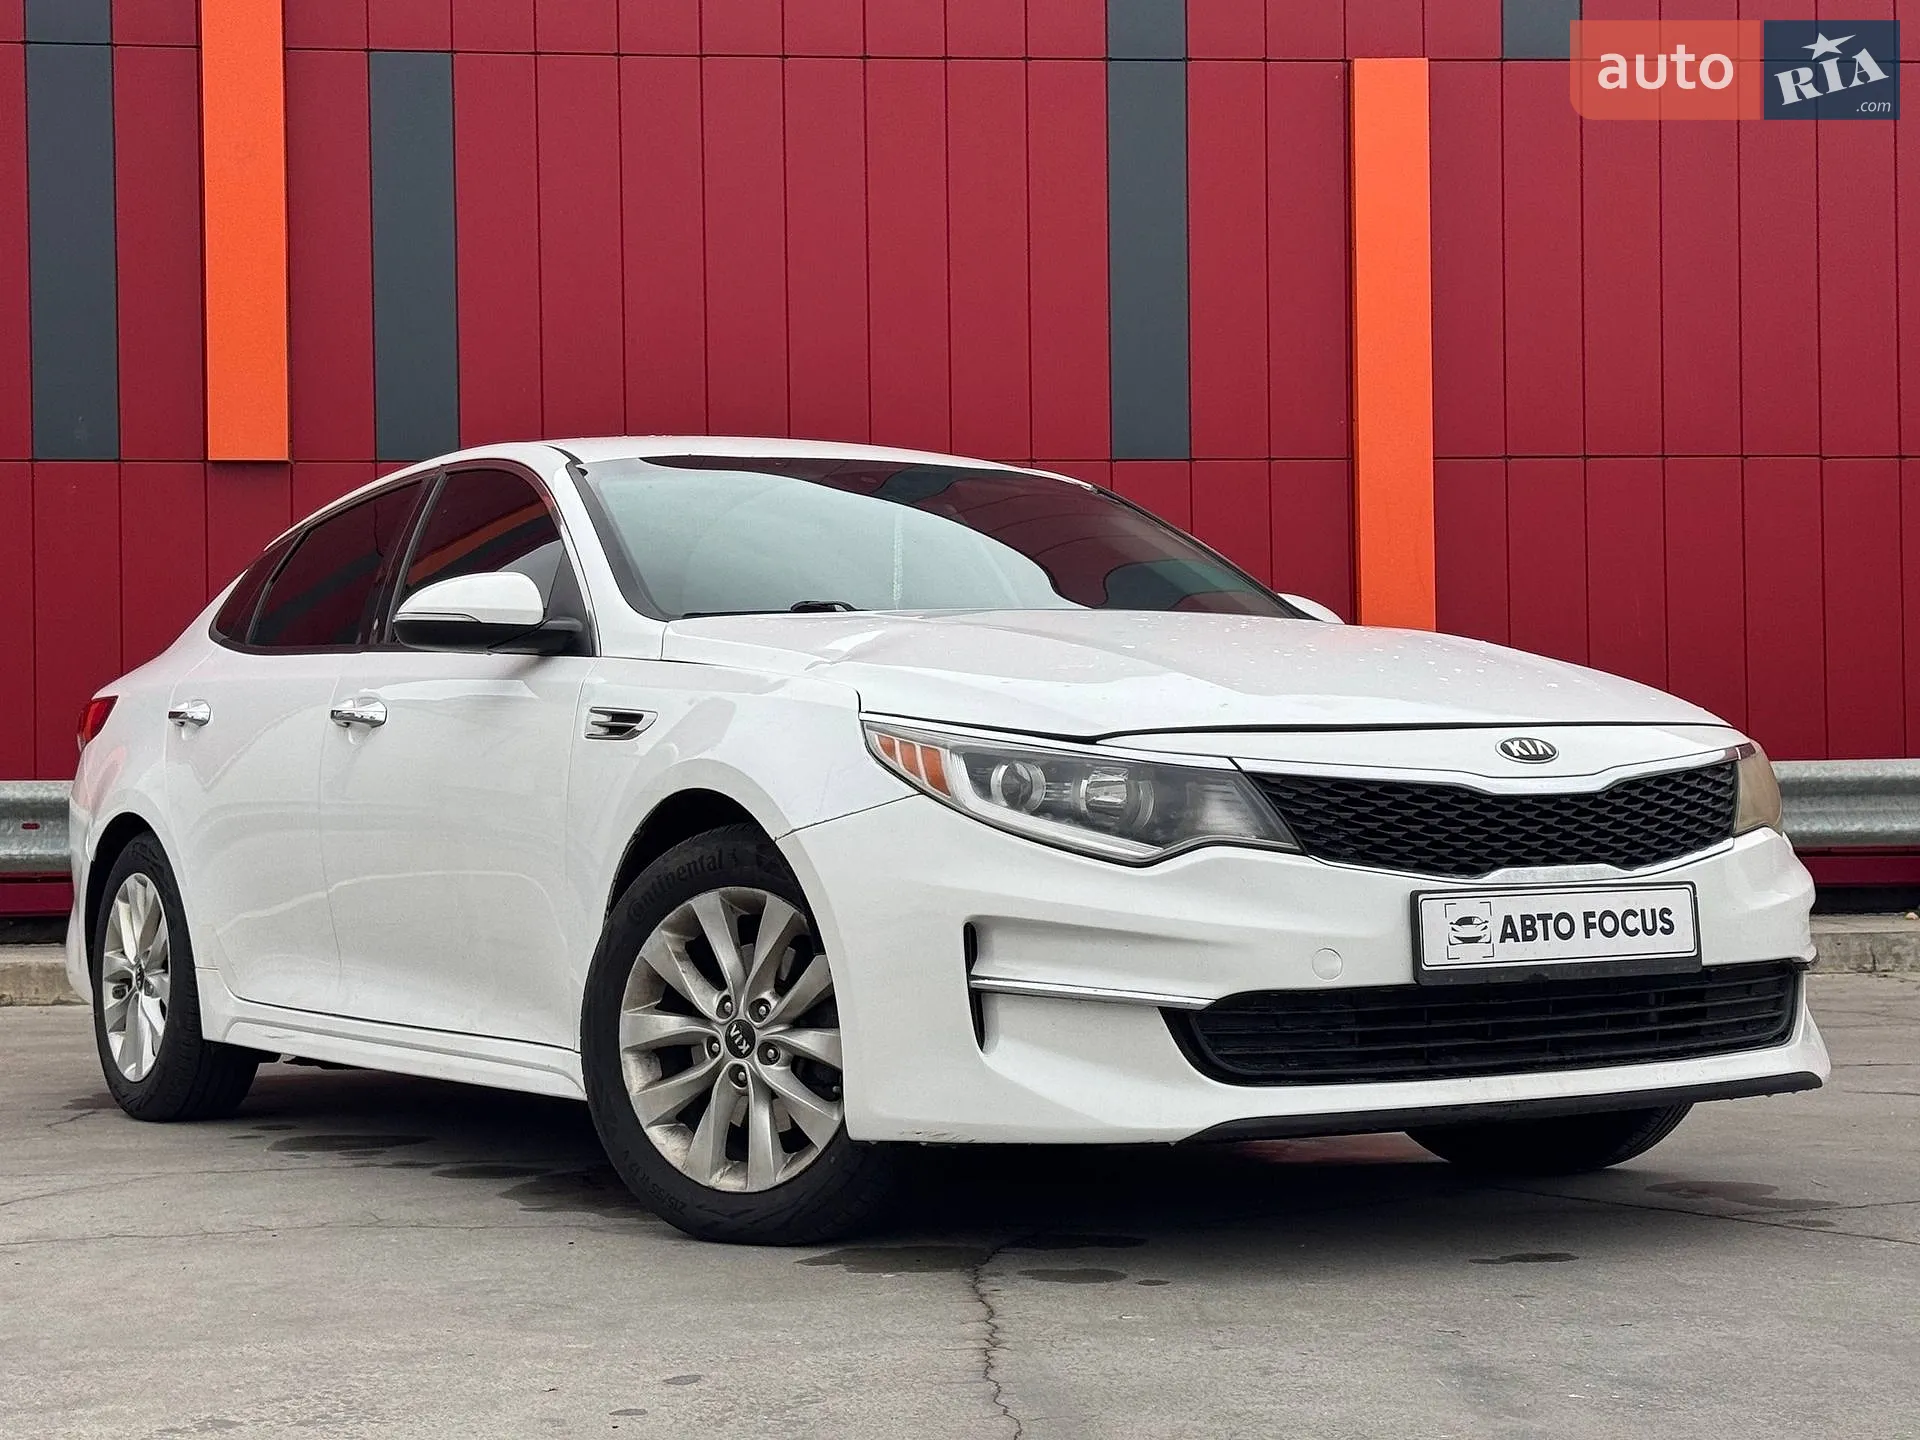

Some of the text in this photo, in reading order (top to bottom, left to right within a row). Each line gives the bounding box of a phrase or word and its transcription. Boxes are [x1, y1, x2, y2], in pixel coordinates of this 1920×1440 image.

[1503, 739, 1555, 757] KIA
[628, 847, 723, 923] Continental
[1499, 906, 1676, 944] АВТО FOCUS
[730, 1023, 751, 1055] KIA
